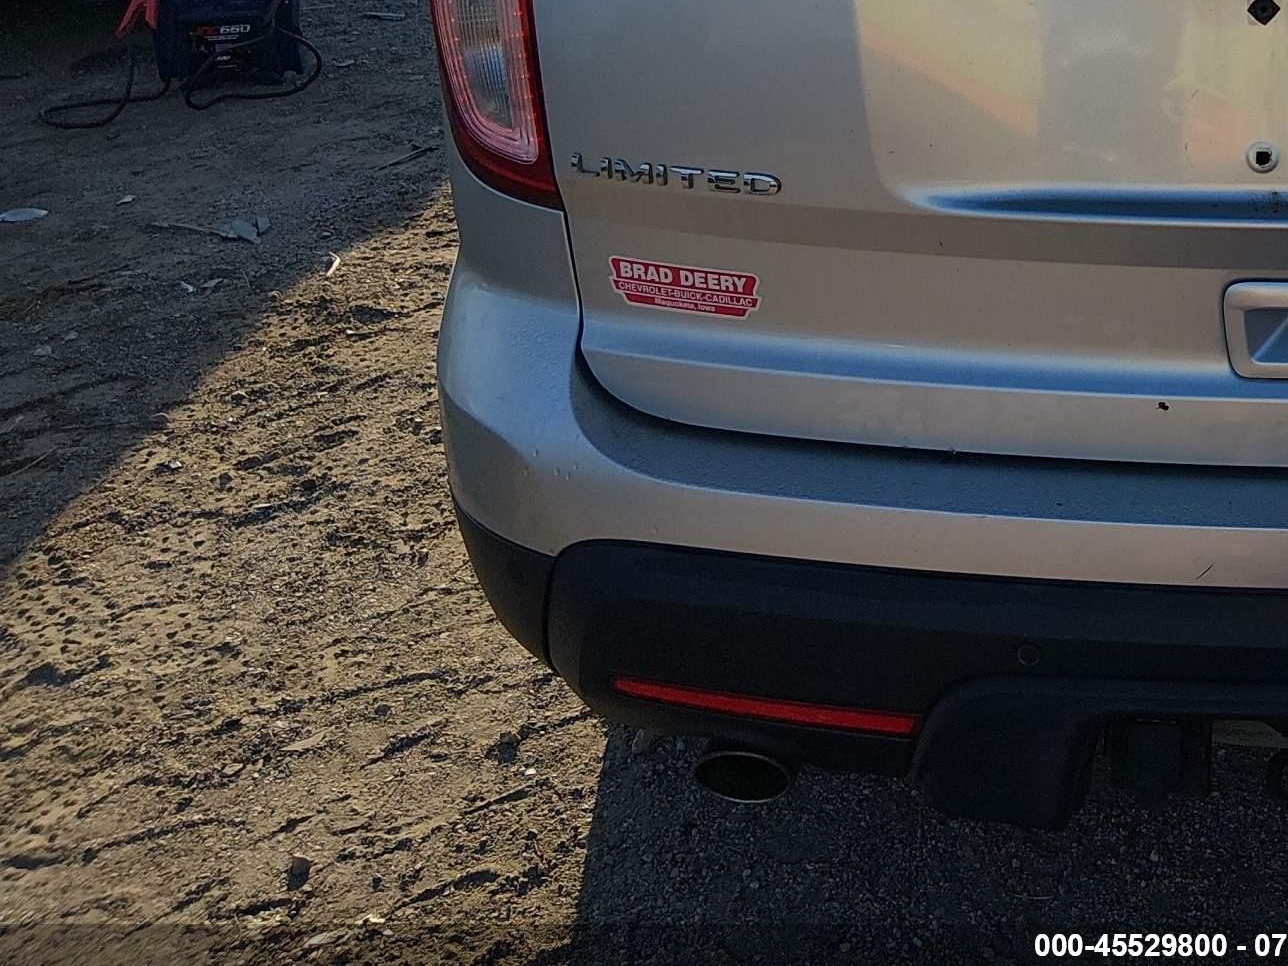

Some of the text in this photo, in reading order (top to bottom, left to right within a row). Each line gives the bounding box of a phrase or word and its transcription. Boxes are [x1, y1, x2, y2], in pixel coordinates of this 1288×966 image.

[570, 152, 783, 196] LIMITED
[619, 261, 747, 293] BRAD DEERY
[618, 281, 753, 307] CHEVROLET-BUICK-CADILLAC
